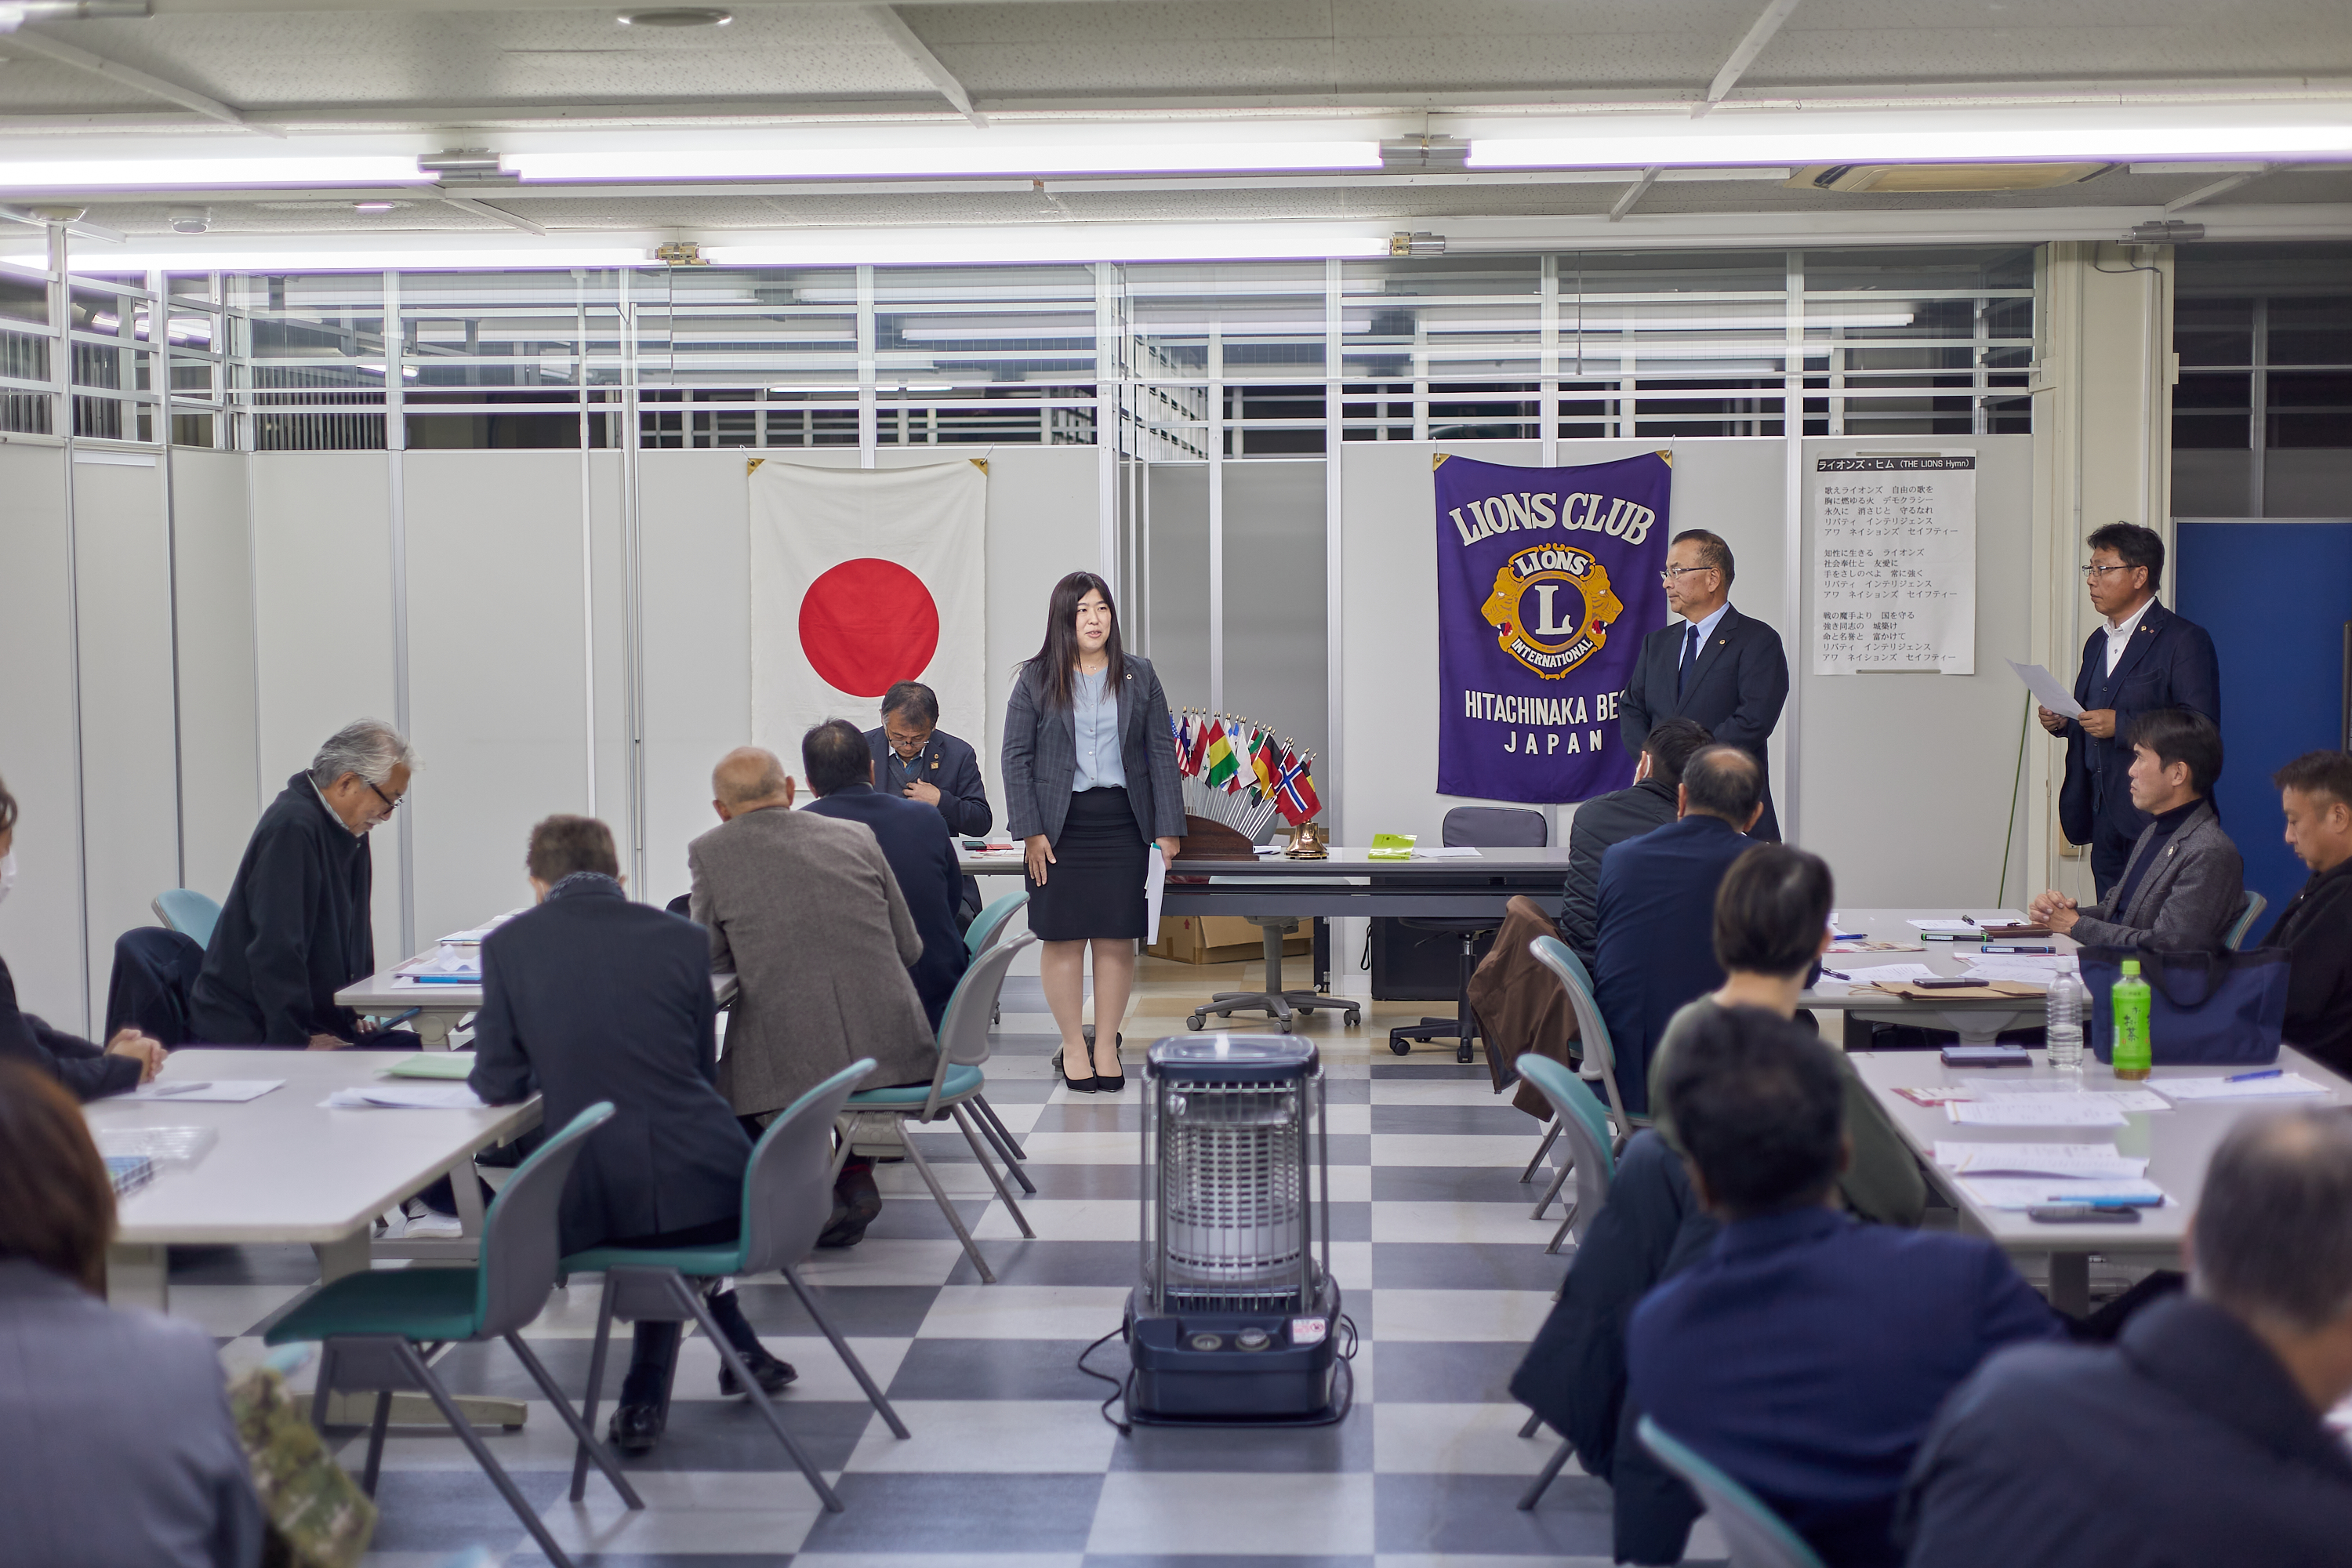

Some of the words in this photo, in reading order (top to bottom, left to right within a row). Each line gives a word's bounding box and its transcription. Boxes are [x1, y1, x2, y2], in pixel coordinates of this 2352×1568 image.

[1819, 459, 1894, 470] ライオンズ・ヒム
[1825, 486, 1882, 495] 歌えライオンズ
[1893, 485, 1933, 494] 自由の歌を
[1449, 492, 1556, 546] LIONS
[1562, 492, 1656, 546] CLUB
[1515, 550, 1588, 576] LIONS
[1875, 559, 1898, 568] 友愛に
[1890, 569, 1922, 578] 常に強く
[1535, 585, 1573, 635] L
[1824, 622, 1864, 630] 強き同志の
[1511, 638, 1593, 668] INTERNATIONAL
[1465, 690, 1588, 725] HITACHINAKA
[1504, 729, 1602, 755] JAPAN
